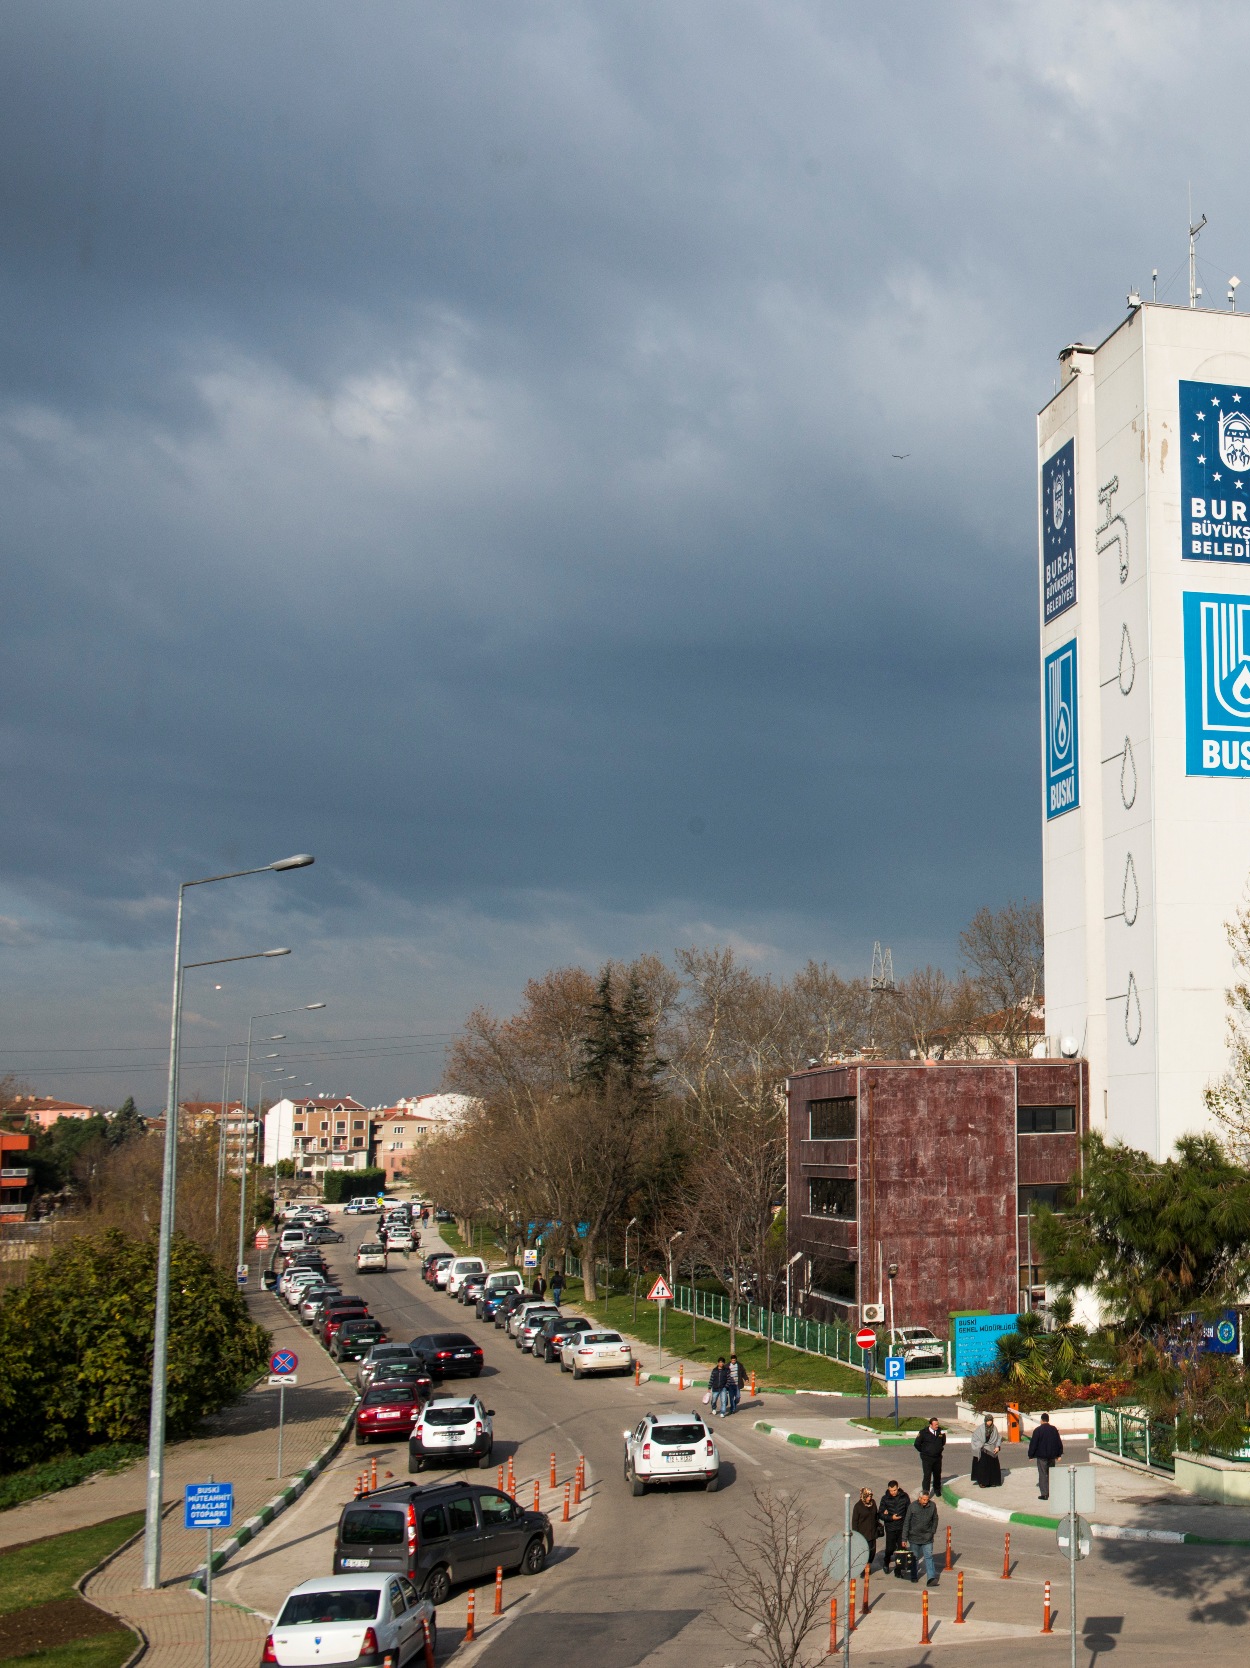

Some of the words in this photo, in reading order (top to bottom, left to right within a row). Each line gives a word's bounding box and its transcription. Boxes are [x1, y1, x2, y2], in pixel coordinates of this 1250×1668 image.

[1046, 547, 1074, 583] BURSA
[1046, 568, 1074, 599] BÜYÜKŞEHİR
[1046, 582, 1075, 615] BELEDİYESİ
[1050, 768, 1075, 812] BUSKİ
[958, 1318, 977, 1326] BUSKİ
[889, 1360, 901, 1378] P
[190, 1502, 228, 1510] ARAÇLARI
